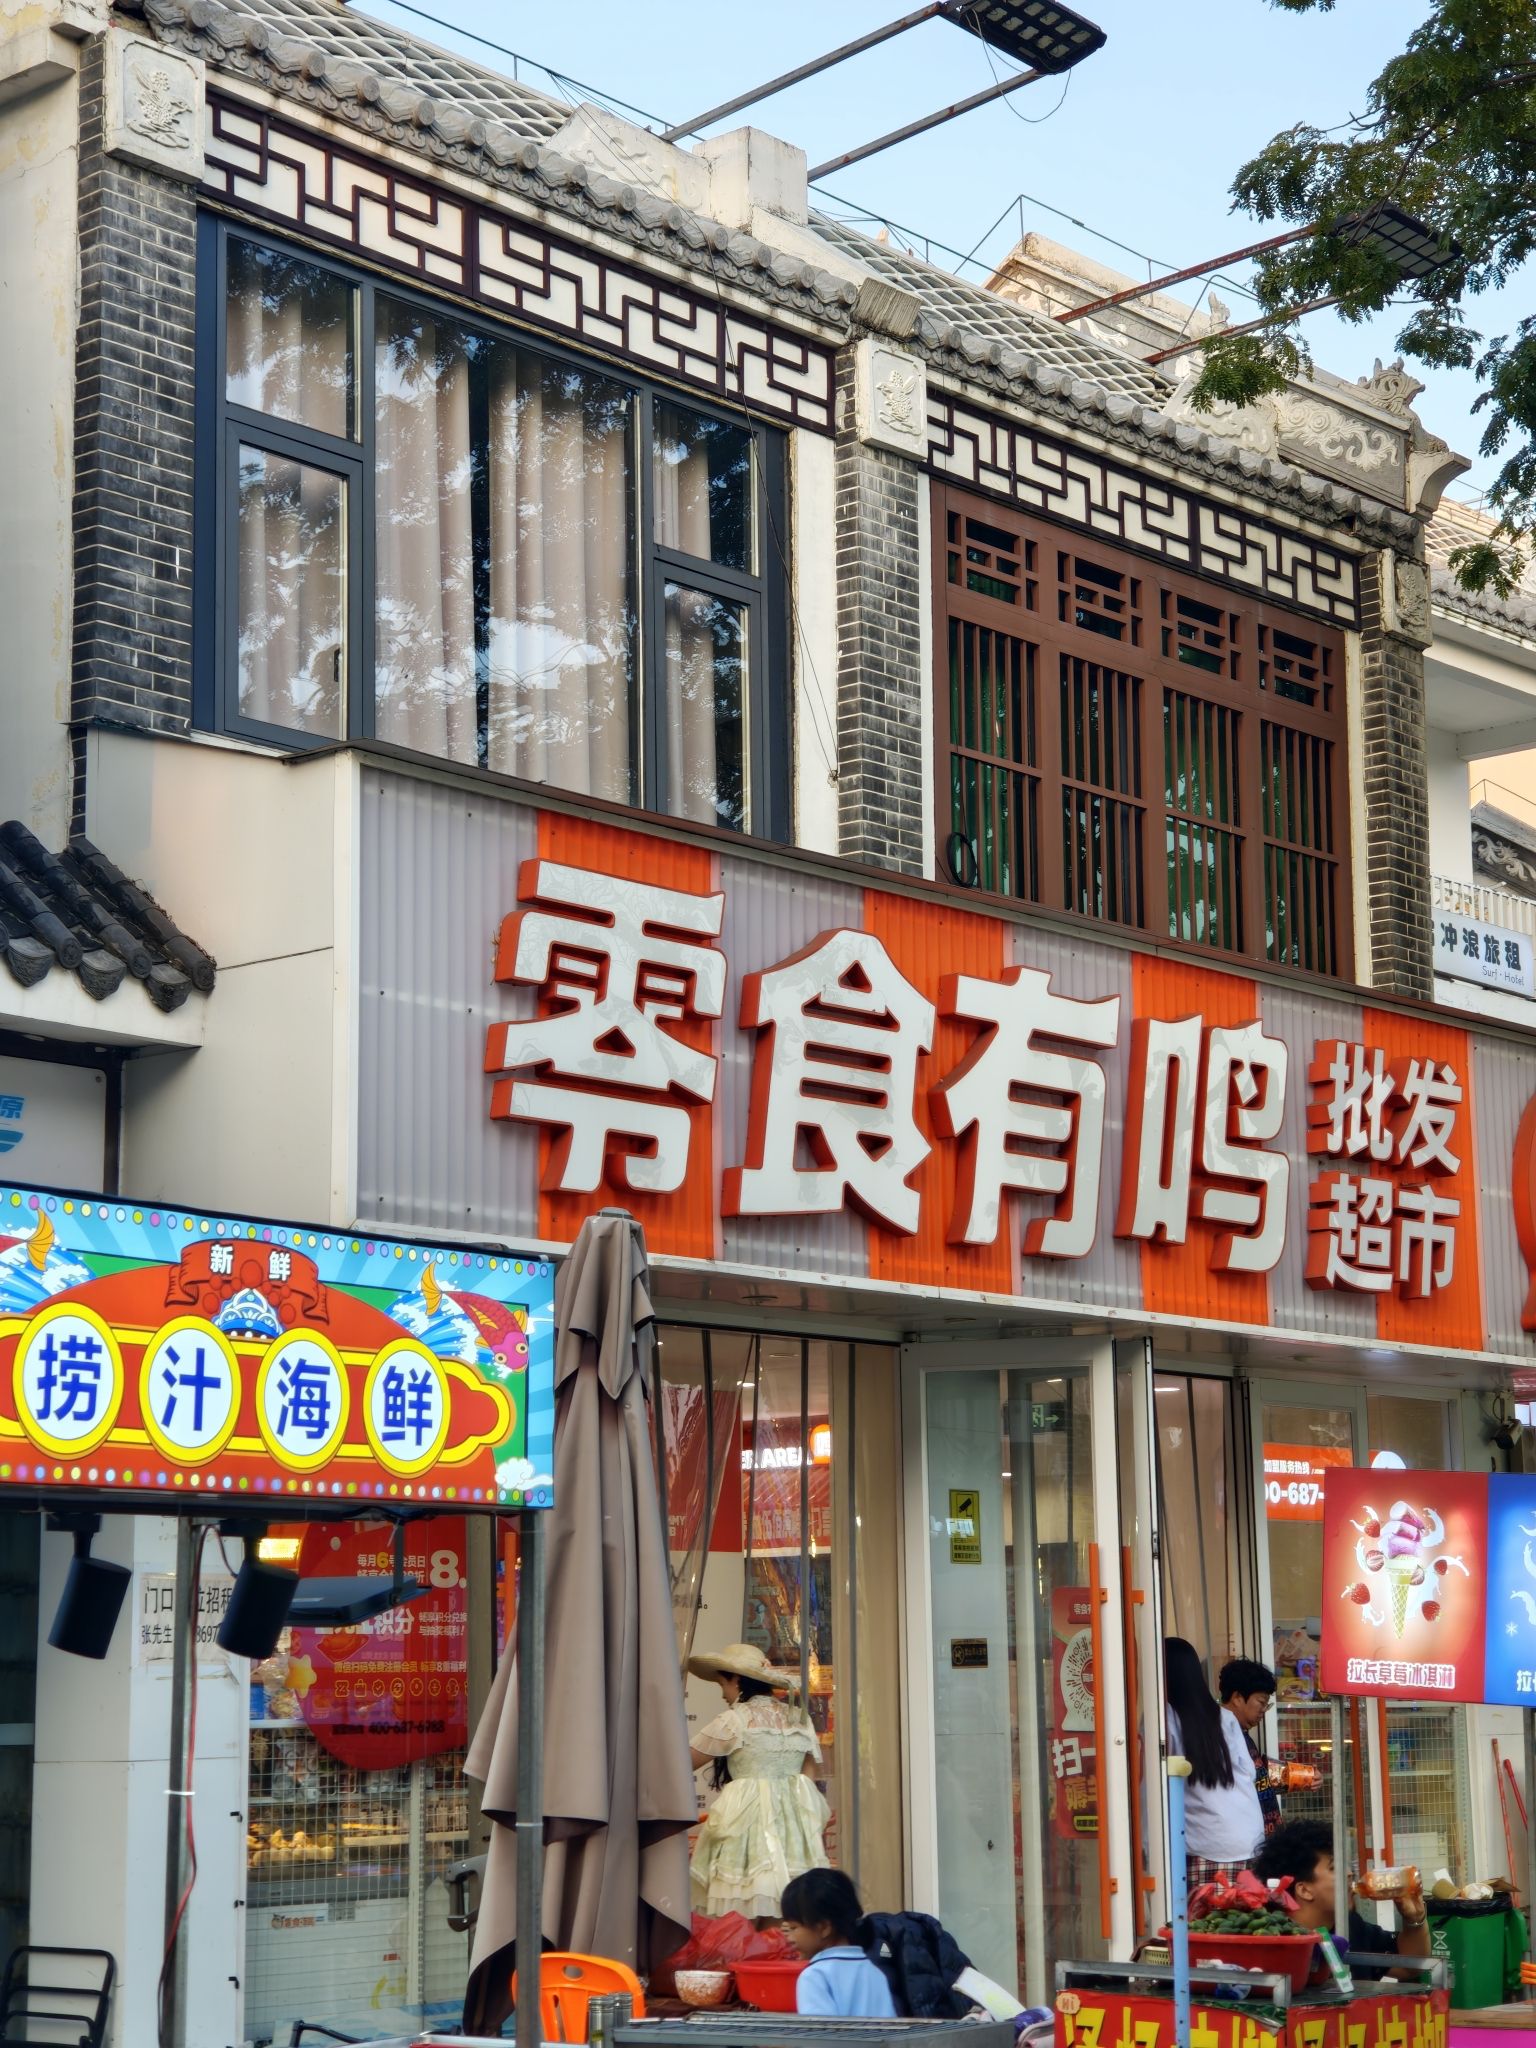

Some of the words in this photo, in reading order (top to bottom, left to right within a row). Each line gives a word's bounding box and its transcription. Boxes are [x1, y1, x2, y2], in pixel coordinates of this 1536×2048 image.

[1430, 920, 1522, 972] 冲浪旅租
[1482, 965, 1498, 981] Surf
[1504, 971, 1525, 986] Hotel
[486, 857, 1290, 1274] 零食有鸣
[1311, 1039, 1462, 1176] 批发
[1309, 1171, 1461, 1298] 超市
[210, 1243, 292, 1282] 新鲜
[36, 1333, 433, 1447] 捞汁海鲜
[1347, 1658, 1455, 1689] 拉长草莓冰淇淋
[1516, 1669, 1536, 1692] 拉
